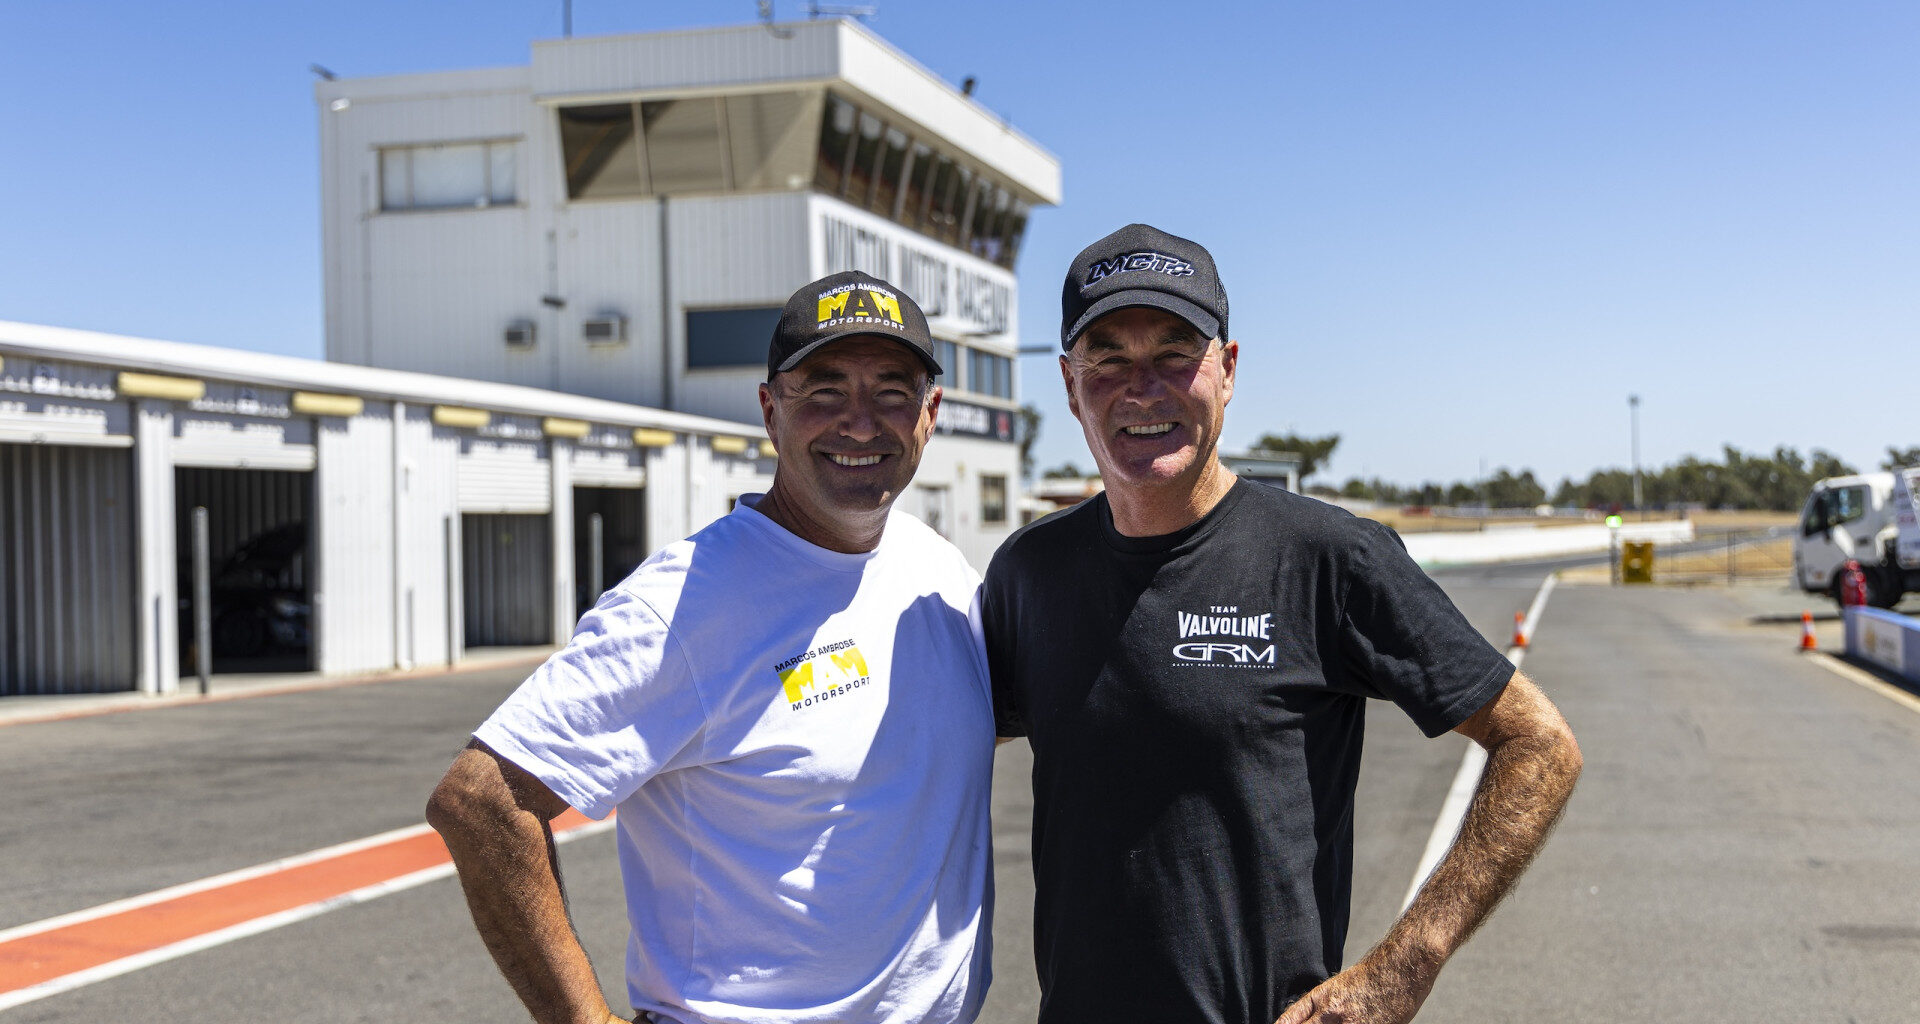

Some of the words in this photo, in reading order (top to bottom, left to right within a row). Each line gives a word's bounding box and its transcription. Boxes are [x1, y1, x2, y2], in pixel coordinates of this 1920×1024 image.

[818, 283, 856, 300] MARCOS
[817, 291, 904, 325] MAM
[817, 316, 905, 331] MOTORSPORT
[1210, 605, 1237, 614] TEAM
[1178, 610, 1271, 640] VALVOLINE
[774, 650, 817, 673] MARCOS
[817, 638, 856, 656] AMBROSE
[1172, 643, 1275, 663] GRM
[777, 647, 869, 704] MAM
[792, 676, 871, 712] MOTORSPORT
